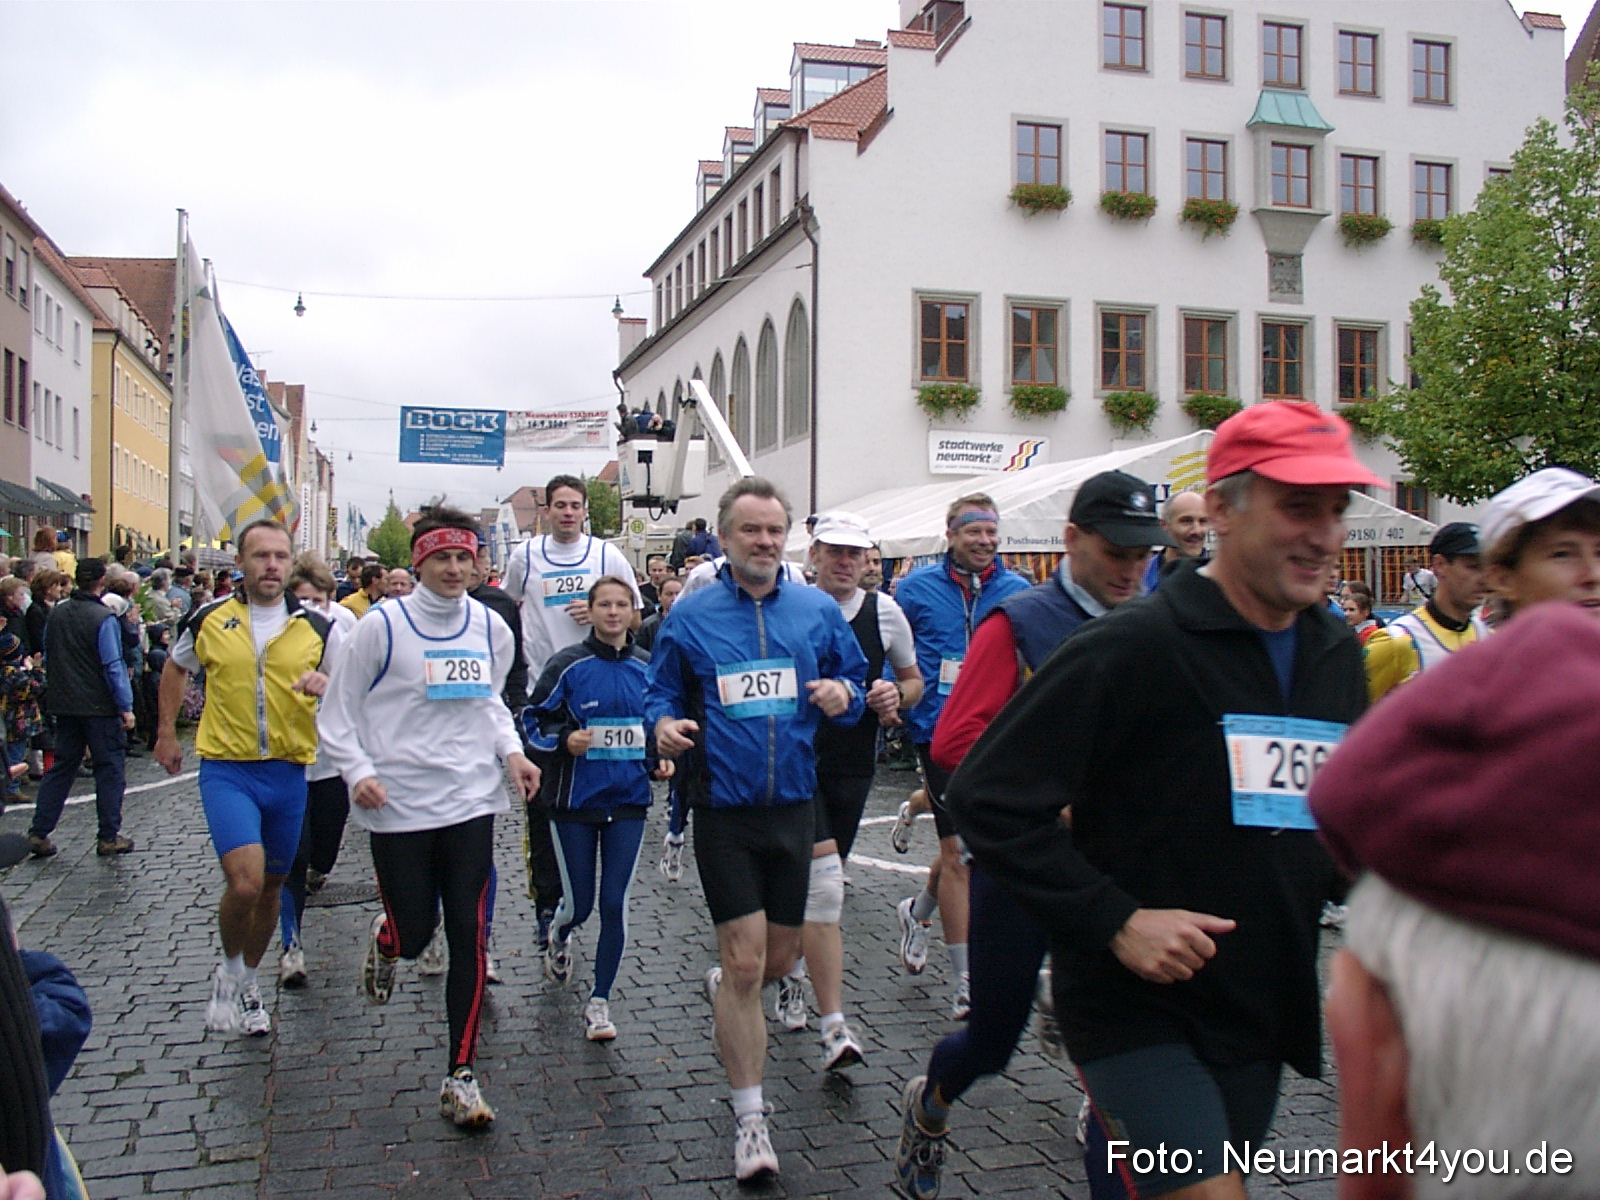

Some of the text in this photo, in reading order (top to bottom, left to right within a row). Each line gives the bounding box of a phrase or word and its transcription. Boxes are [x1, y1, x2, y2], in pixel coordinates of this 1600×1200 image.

[405, 409, 500, 433] BOCK
[938, 440, 1004, 452] stadtwerke
[936, 452, 993, 463] neumarkt
[1386, 528, 1404, 539] 402
[556, 576, 584, 593] 292
[446, 660, 481, 680] 289
[741, 672, 781, 698] 267
[604, 730, 634, 746] 510
